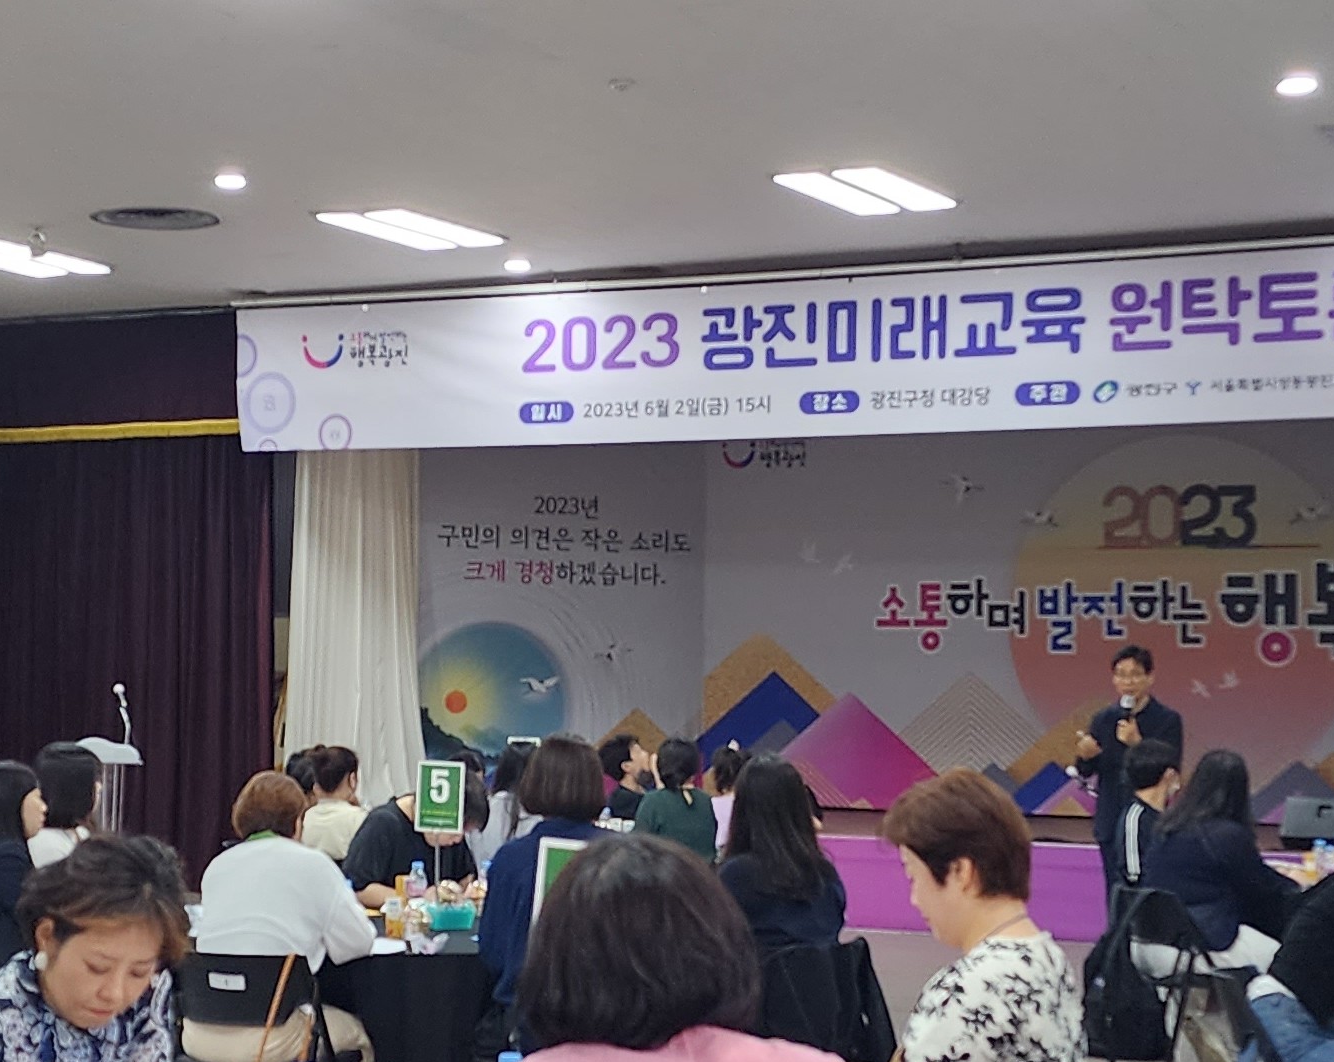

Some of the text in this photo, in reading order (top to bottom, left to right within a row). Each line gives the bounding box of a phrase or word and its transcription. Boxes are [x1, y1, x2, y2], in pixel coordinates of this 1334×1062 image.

[522, 313, 680, 374] 2023
[700, 287, 1085, 371] 광진미래교육
[530, 404, 563, 422] 일시
[583, 400, 639, 418] 2023년
[645, 400, 670, 417] 6월
[736, 395, 771, 414] 15시
[534, 495, 599, 519] 2023년
[1102, 484, 1257, 548] 2023
[437, 524, 692, 552] 구민의 의견은 작은 소리도
[464, 560, 667, 586] 크게 경청하겠습니다.
[875, 578, 1029, 653] 소통하며
[1036, 578, 1208, 654] 발전하는
[430, 768, 451, 804] 5
